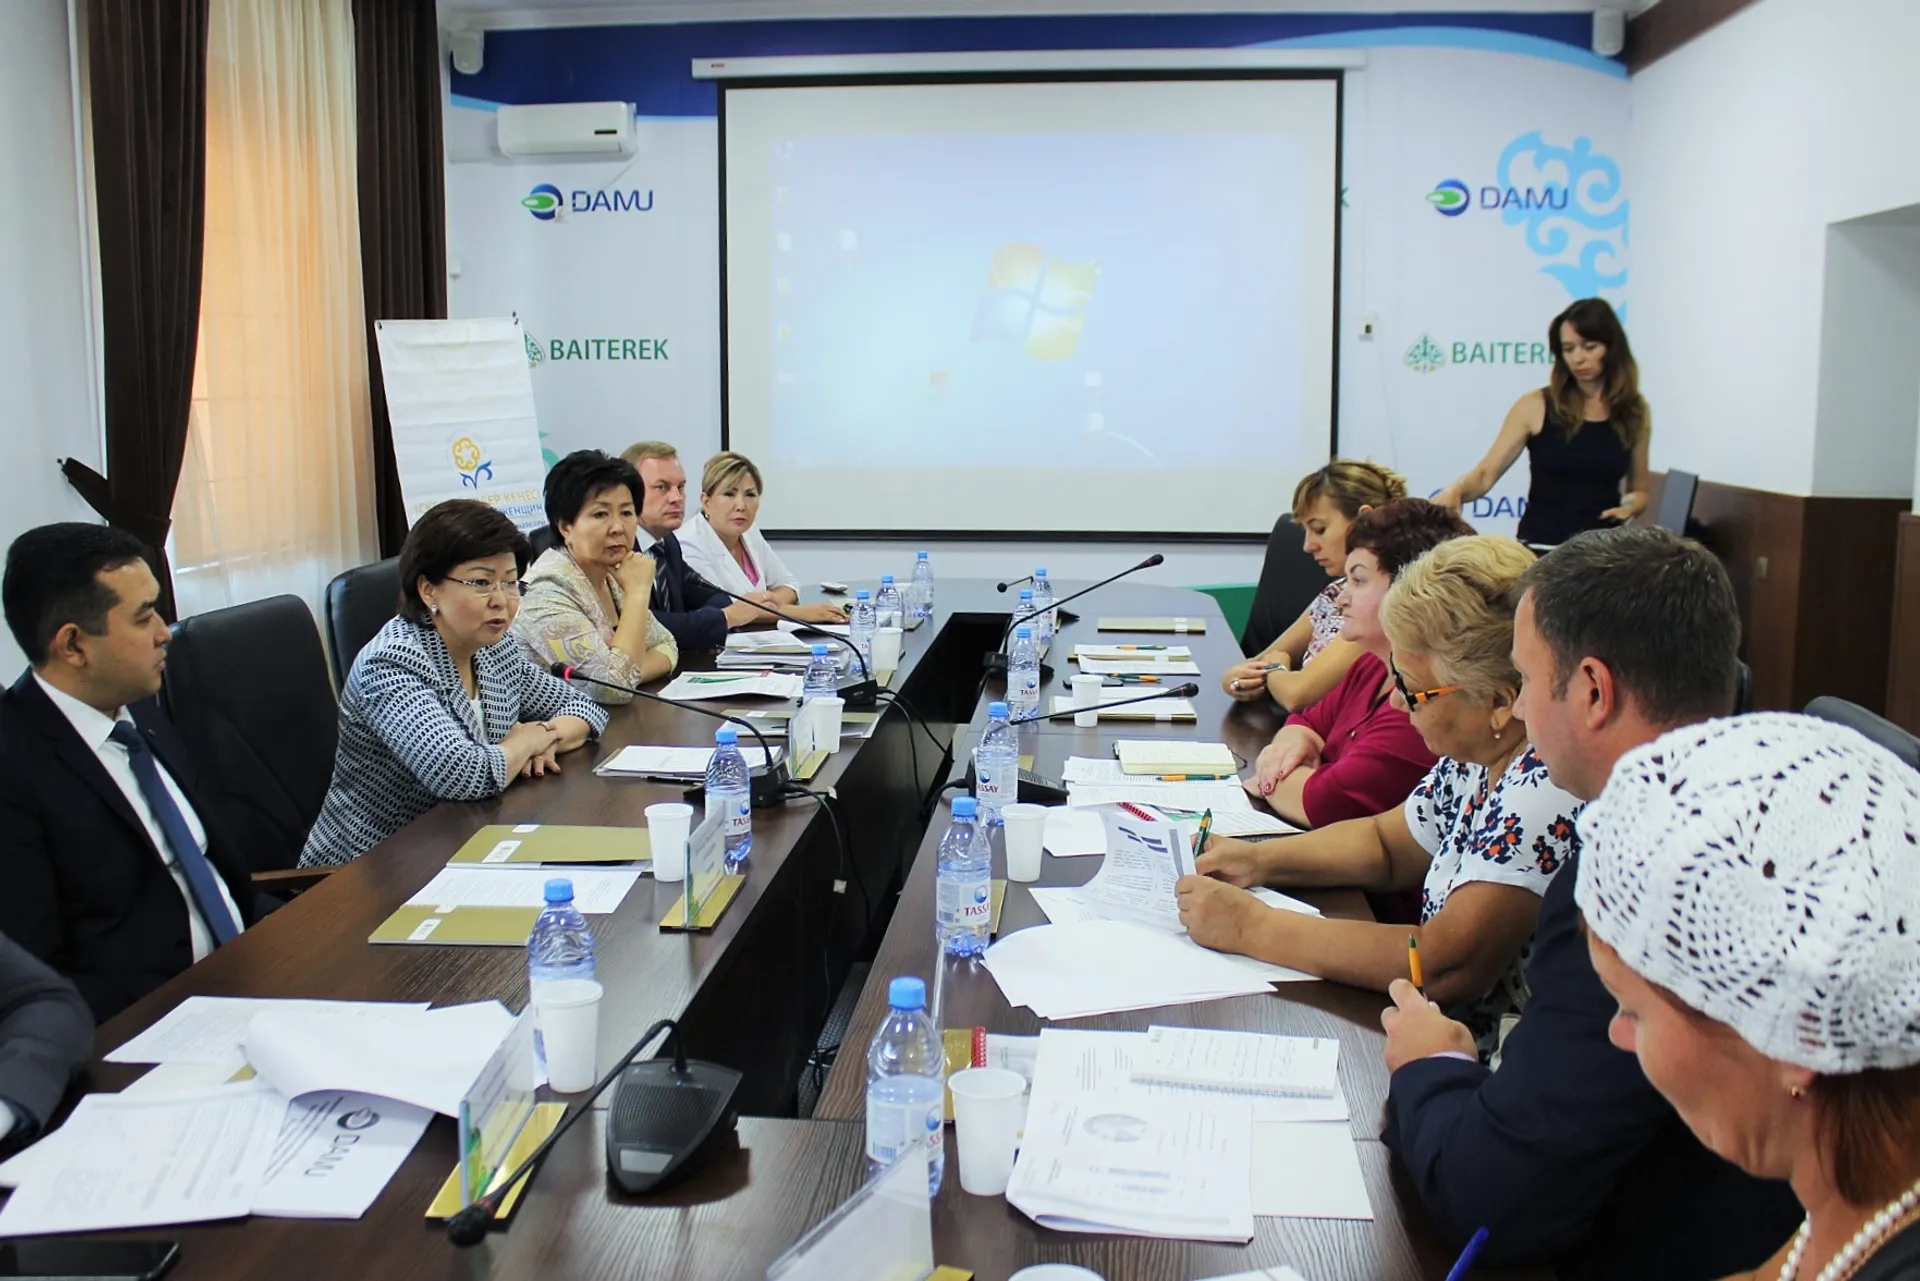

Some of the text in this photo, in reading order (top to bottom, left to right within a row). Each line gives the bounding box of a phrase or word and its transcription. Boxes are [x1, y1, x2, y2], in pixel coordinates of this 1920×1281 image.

[571, 189, 654, 212] DAMU
[1480, 187, 1568, 210] DAMU
[549, 339, 670, 361] BAITEREK
[304, 1134, 361, 1177] DAMU
